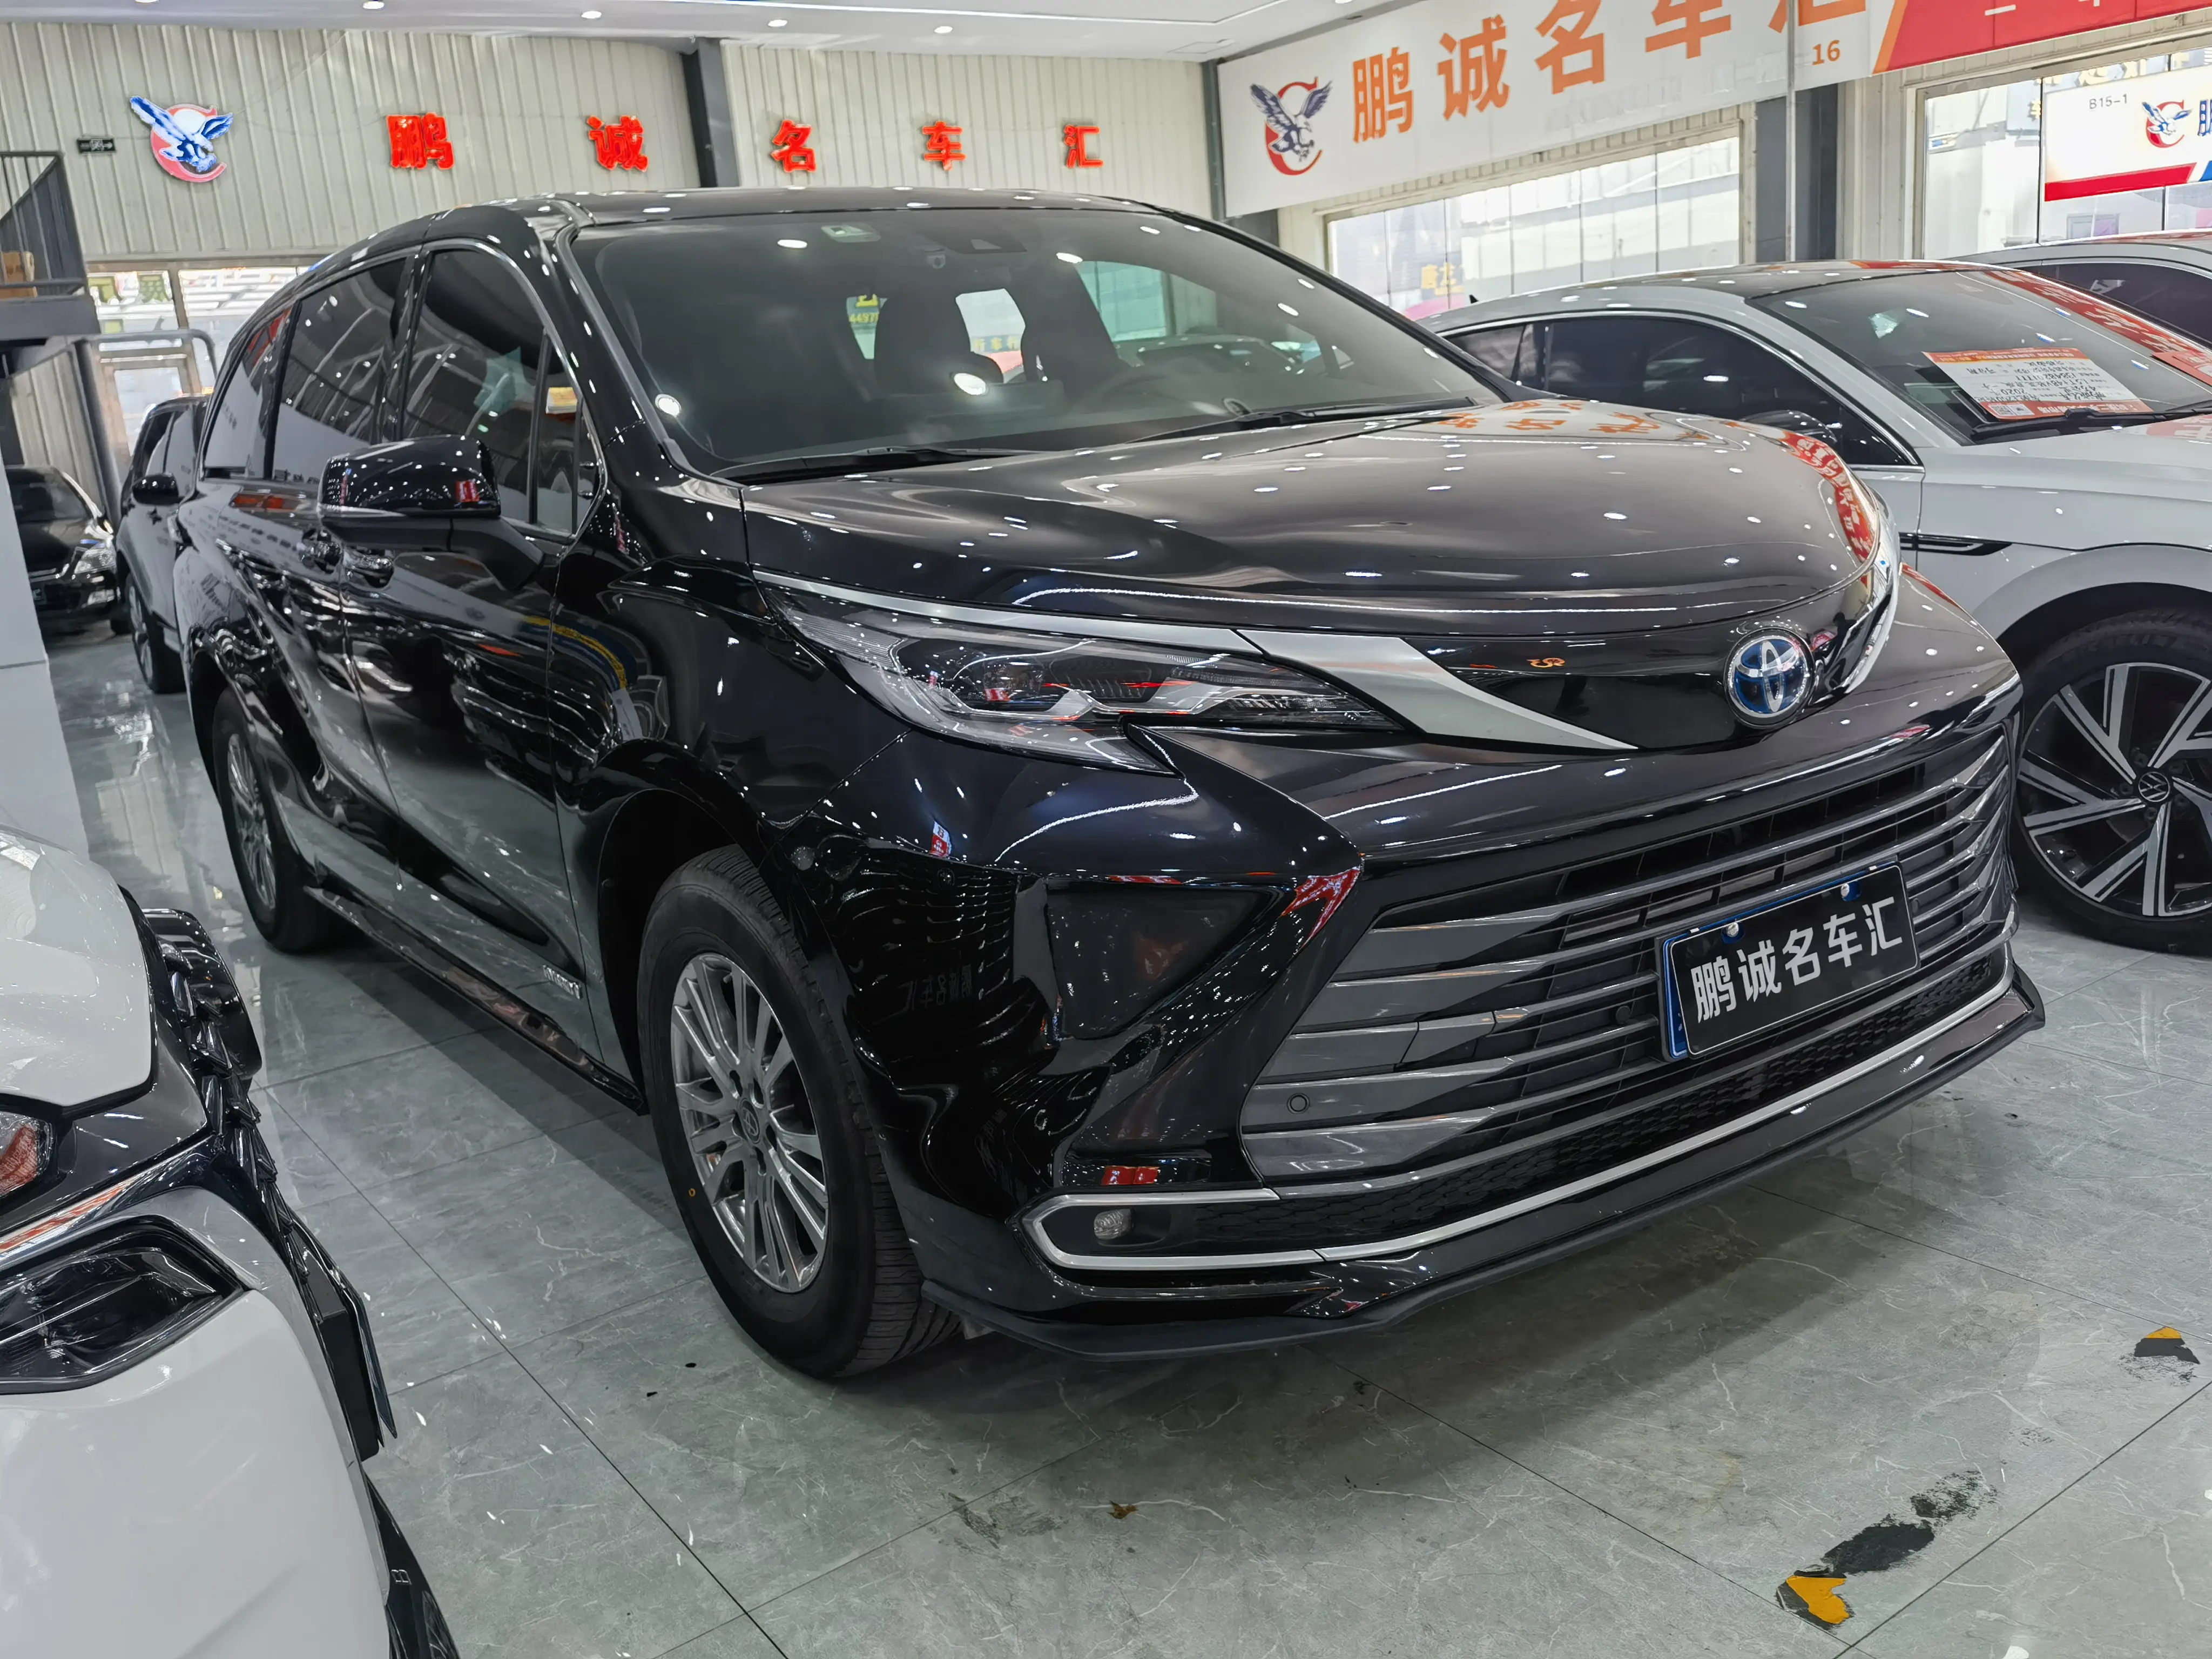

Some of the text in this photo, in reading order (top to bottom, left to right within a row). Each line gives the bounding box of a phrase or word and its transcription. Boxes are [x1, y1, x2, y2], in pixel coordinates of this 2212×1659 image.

[1352, 0, 1866, 143] 鹏诚名车
[1812, 39, 1840, 65] 16
[2089, 93, 2128, 109] B15-1
[386, 112, 1104, 173] 鹏诚名车汇
[1691, 897, 1902, 1023] 鹏诚名车汇
